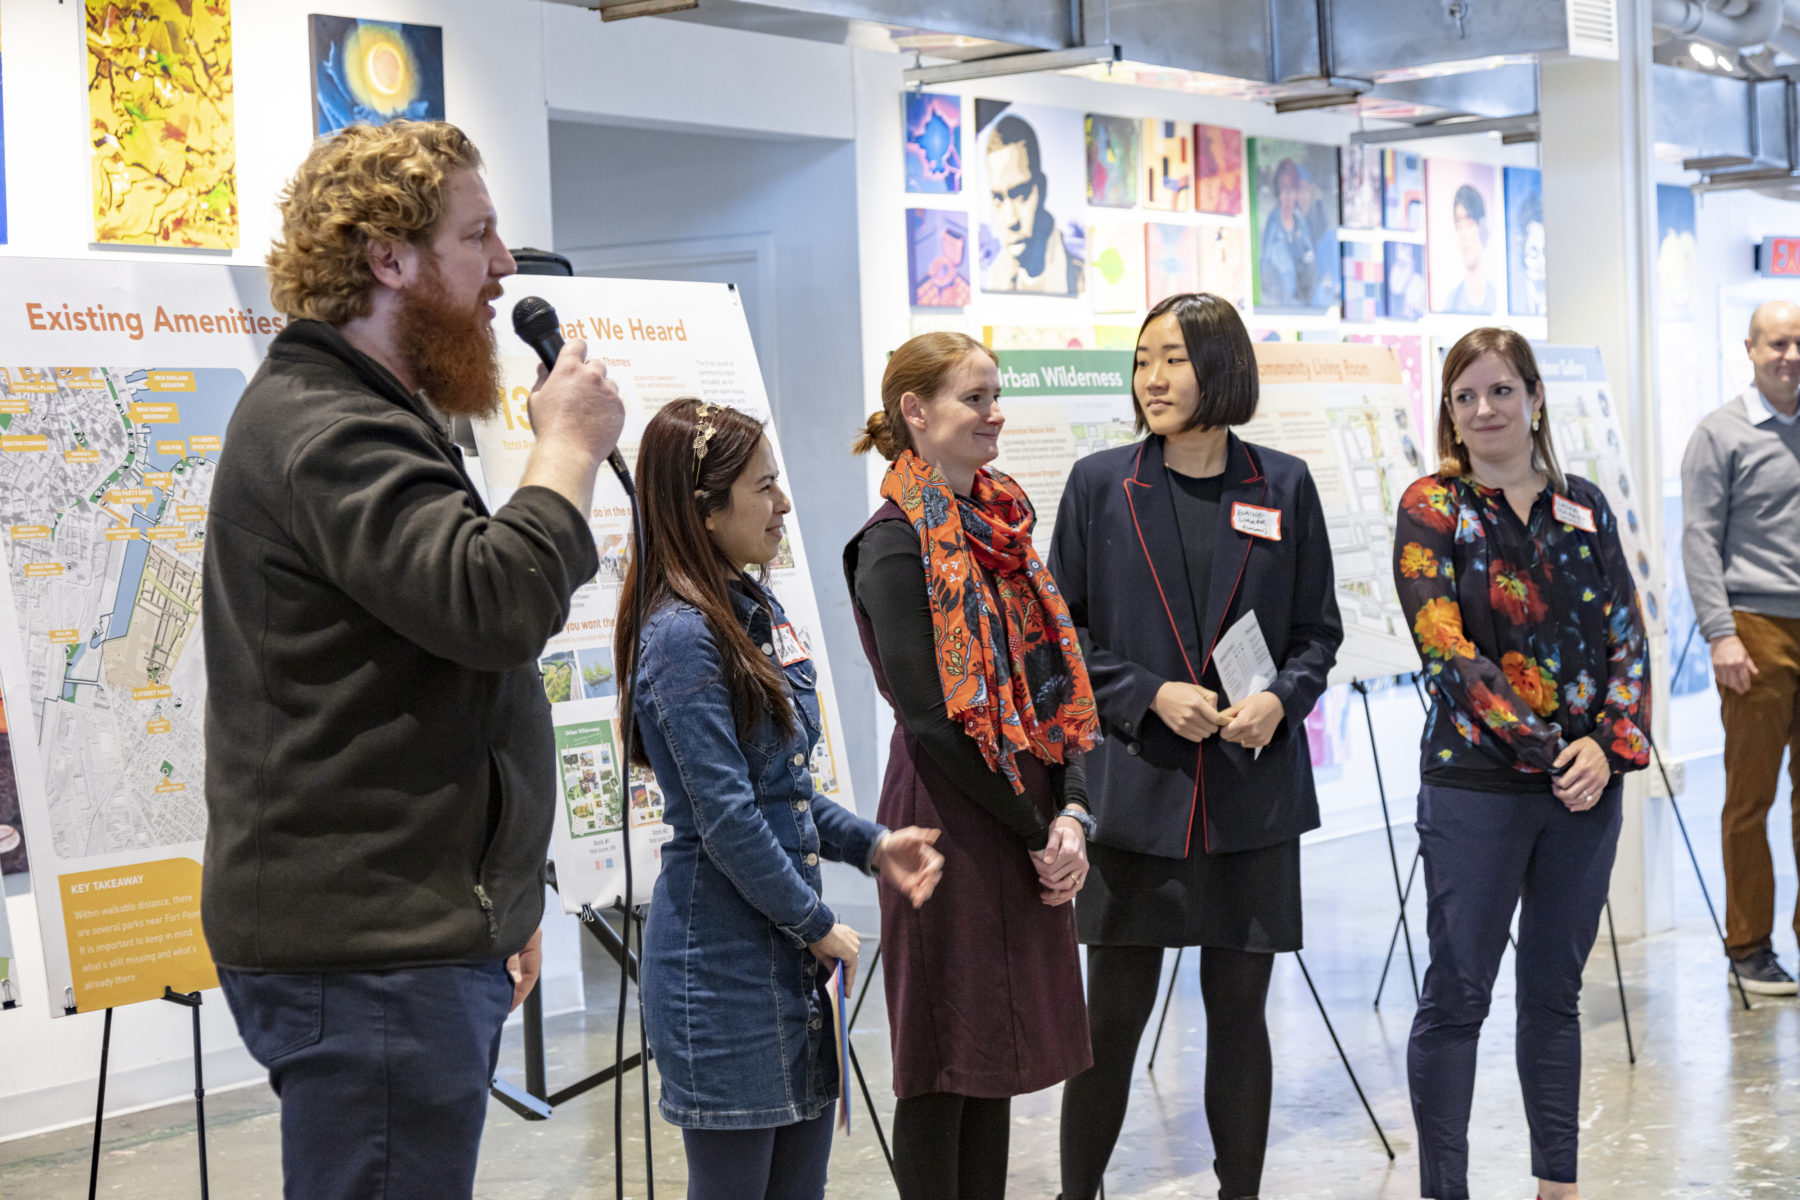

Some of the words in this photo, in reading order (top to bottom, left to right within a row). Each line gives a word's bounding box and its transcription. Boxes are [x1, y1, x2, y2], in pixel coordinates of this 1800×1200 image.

[25, 302, 144, 341] Existing
[154, 305, 285, 335] Amenities
[559, 319, 588, 340] at
[590, 317, 624, 341] We
[628, 317, 688, 342] Heard
[602, 357, 631, 368] Themes
[1258, 358, 1311, 382] ommunity
[1312, 357, 1343, 382] Living
[1343, 358, 1369, 377] Room
[1041, 365, 1124, 388] Wilderness
[603, 505, 613, 517] in
[614, 505, 626, 516] the
[565, 621, 580, 634] you
[581, 619, 602, 630] want
[71, 882, 90, 895] KEY
[92, 874, 144, 891] TAKEAWAY
[74, 909, 100, 920] Within
[102, 902, 136, 916] walkable
[137, 897, 172, 911] distance,
[172, 894, 193, 905] there
[77, 929, 91, 938] are
[92, 921, 121, 935] several
[121, 919, 145, 933] parks
[145, 915, 162, 927] near
[164, 911, 180, 923] Fort
[88, 945, 95, 955] is
[96, 938, 135, 953] important
[136, 936, 144, 946] to
[145, 932, 163, 945] keep
[165, 931, 172, 940] in
[174, 927, 193, 939] mind
[83, 960, 108, 973] what's
[109, 956, 124, 969] still
[125, 952, 156, 965] missing
[157, 947, 171, 960] and
[84, 976, 114, 991] already
[115, 974, 136, 986] there
